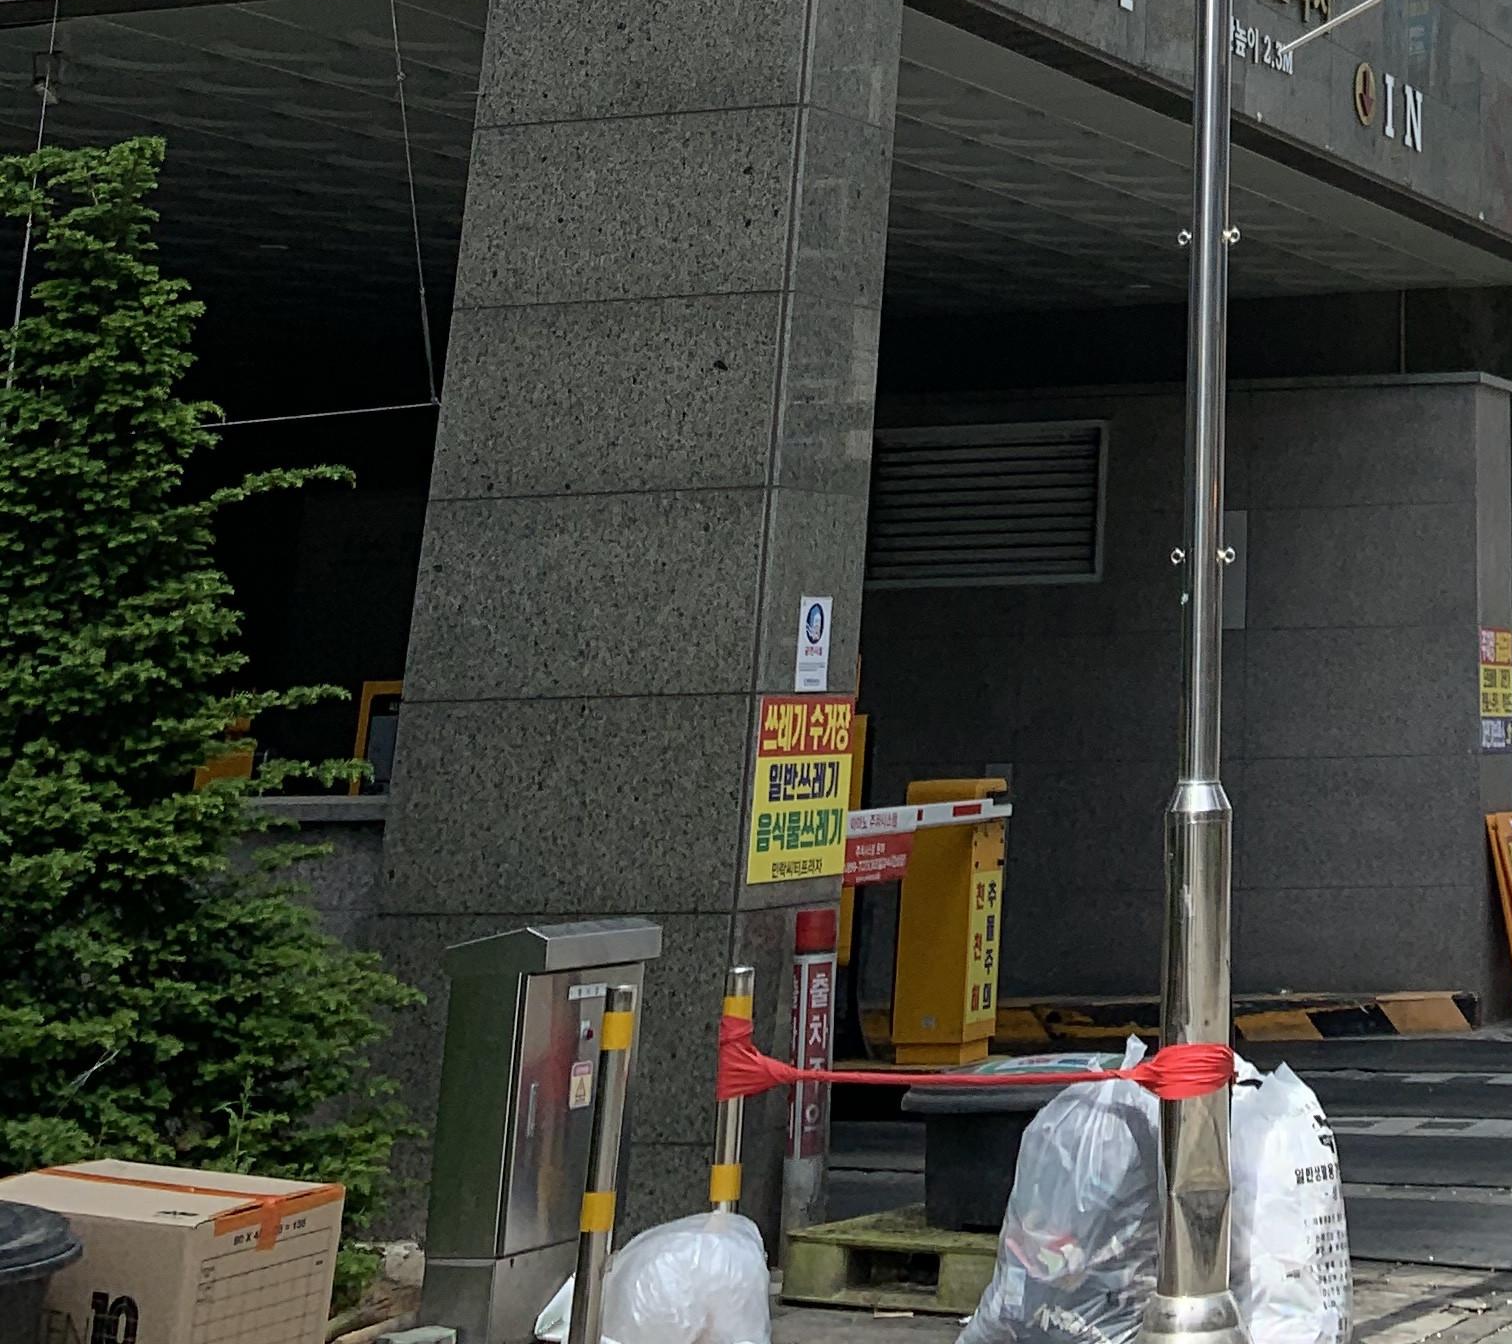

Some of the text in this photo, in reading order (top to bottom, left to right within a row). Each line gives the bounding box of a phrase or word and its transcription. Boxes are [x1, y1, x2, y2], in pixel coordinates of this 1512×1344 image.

[1384, 73, 1424, 153] IN
[763, 702, 852, 752] 쓰레기 수거장
[768, 760, 840, 802] 일반쓰레기
[755, 807, 844, 853] 음식물쓰레기
